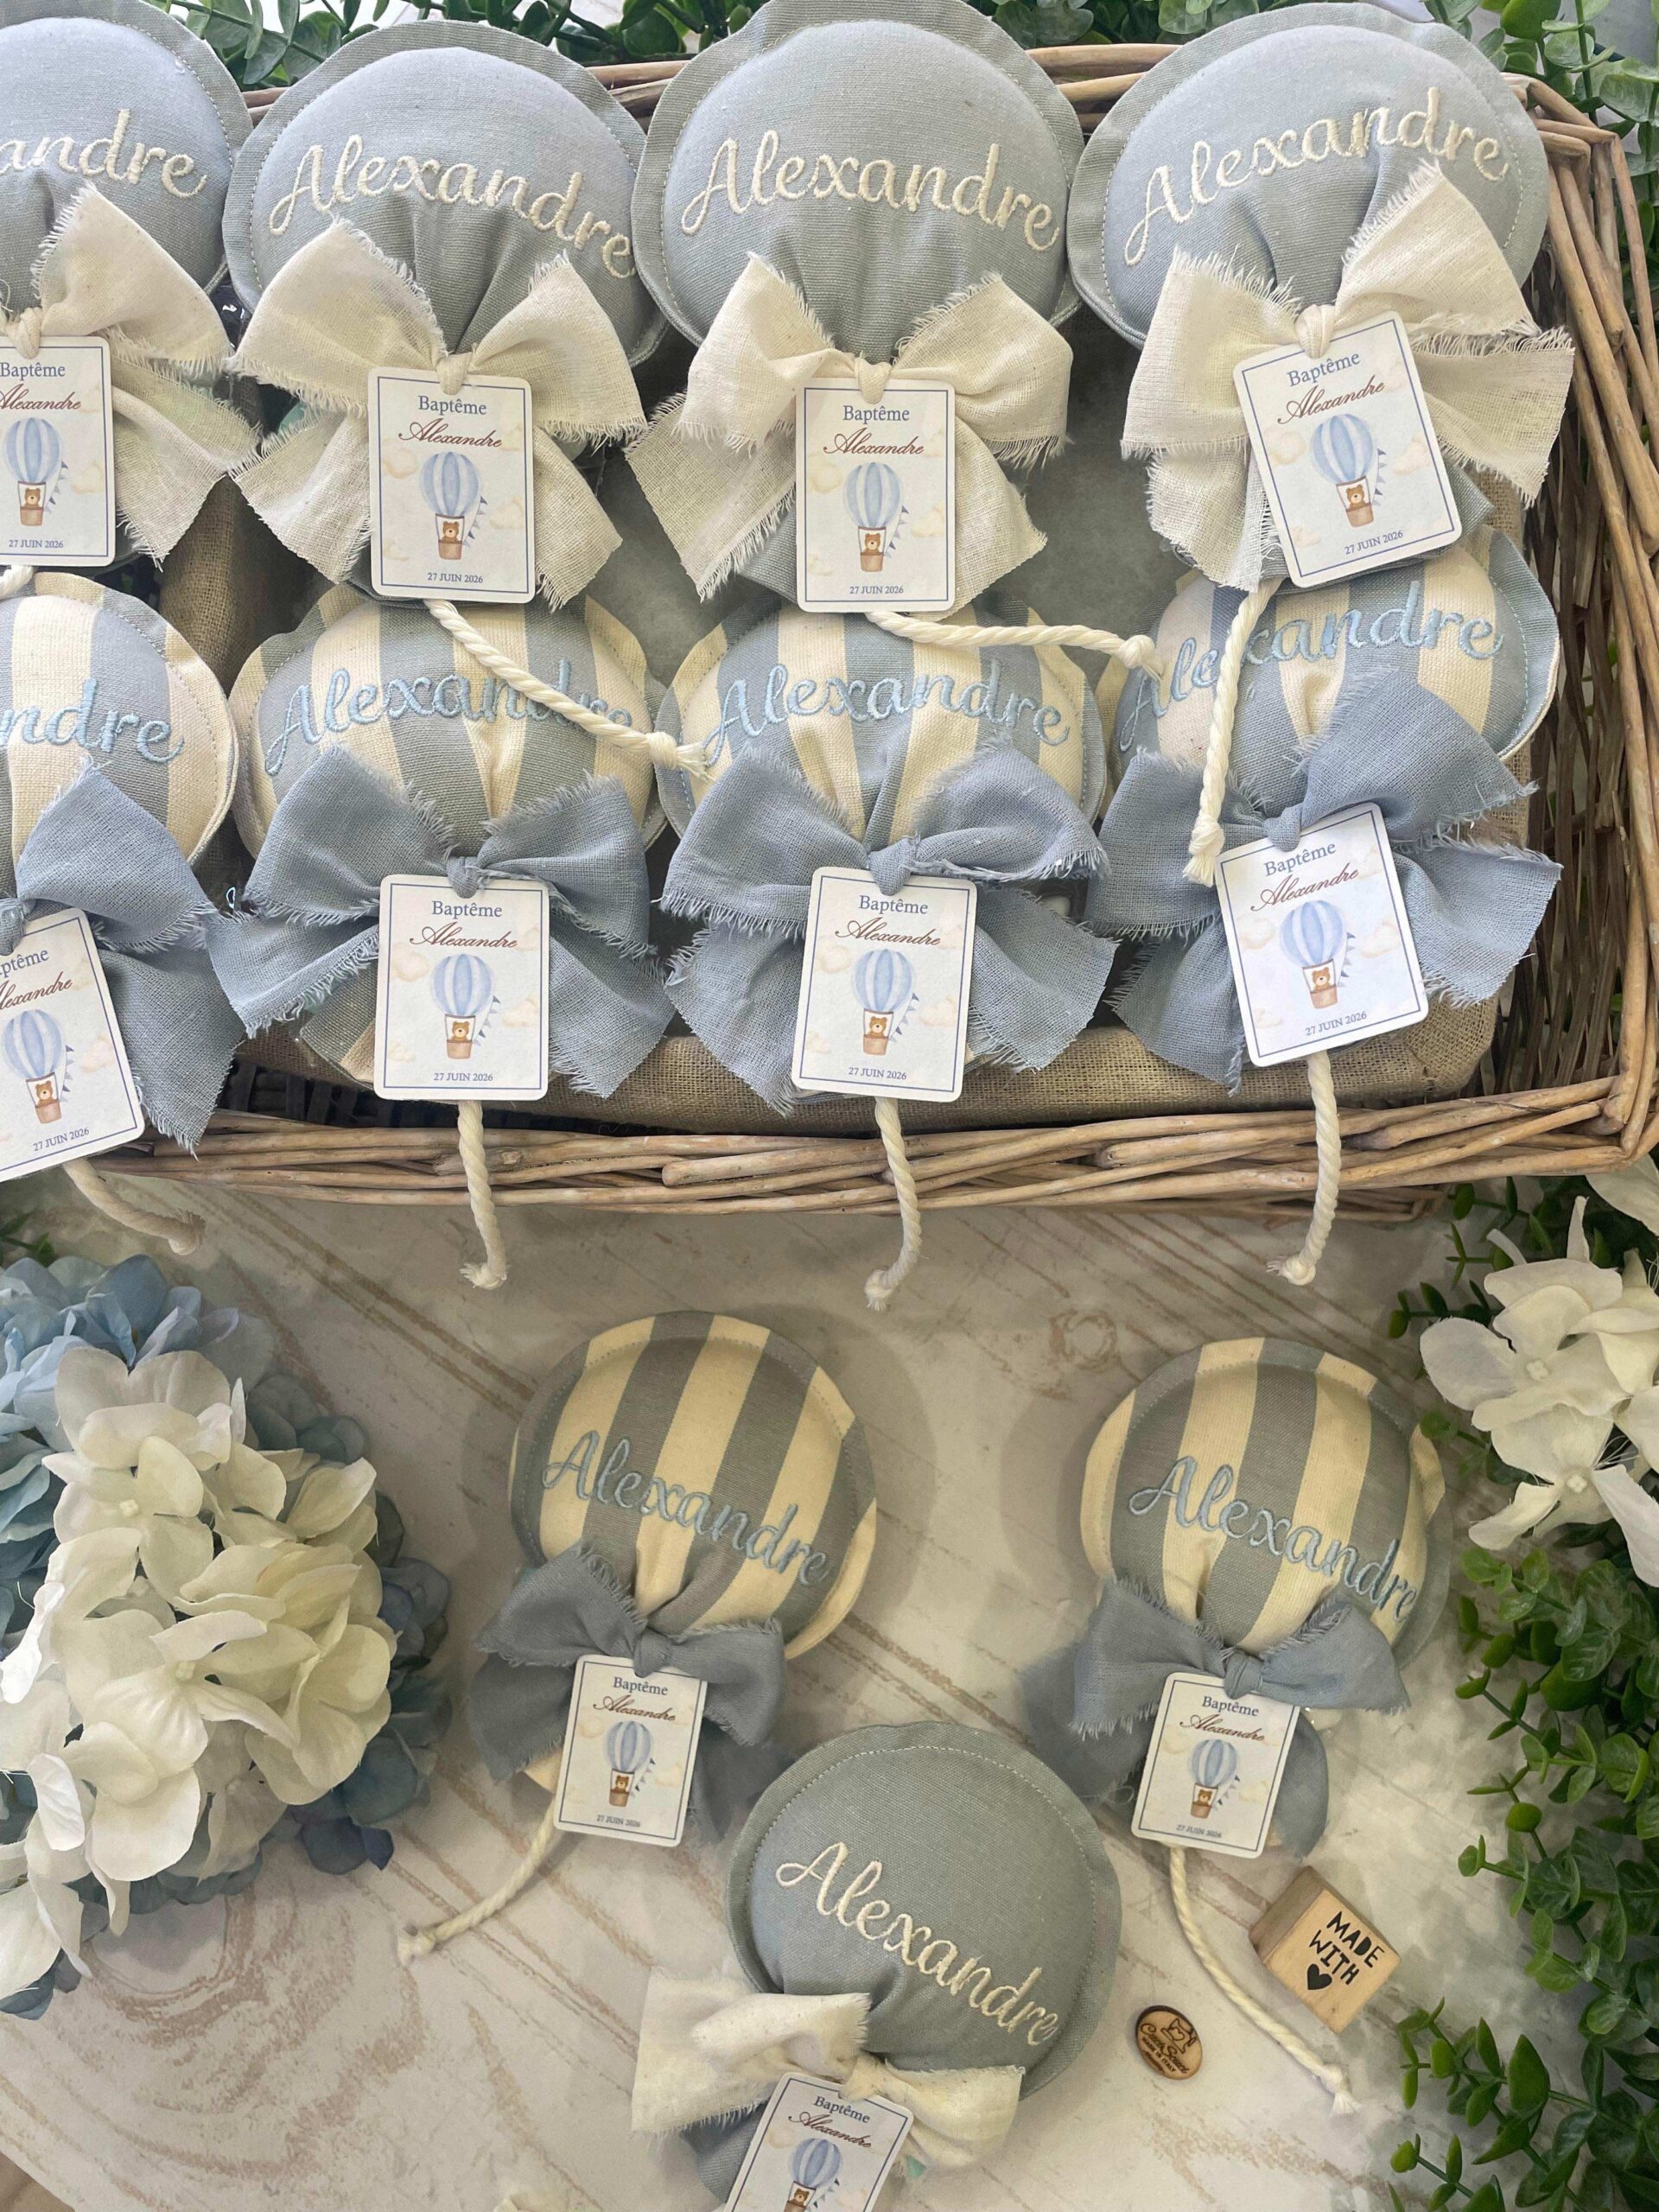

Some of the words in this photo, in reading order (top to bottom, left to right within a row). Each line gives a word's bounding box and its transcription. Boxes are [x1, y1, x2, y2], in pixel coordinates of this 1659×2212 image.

[1124, 86, 1510, 266] Alexandre
[682, 130, 1060, 251] Alexandre
[269, 134, 637, 278] Alexandre
[0, 362, 66, 381] Baptême
[1287, 353, 1361, 387] Baptême
[418, 395, 486, 416] Baptême
[1277, 375, 1385, 424] Alexandre
[843, 405, 909, 424] Baptême
[398, 418, 502, 448] Alexandre
[823, 428, 924, 454] Alexandre
[45, 540, 63, 549] 2026
[1344, 544, 1355, 555] 27
[1356, 537, 1381, 551] JUIN
[1382, 530, 1403, 543] 2026
[428, 572, 438, 581] 27
[439, 573, 461, 582] JUIN
[464, 575, 483, 583] 2026
[885, 586, 904, 594] 2026
[703, 658, 1071, 767] Alexandre
[1264, 842, 1337, 877] Baptême
[1250, 862, 1359, 912] Alexandre
[431, 900, 502, 919] Baptême
[858, 894, 928, 915] Baptême
[409, 921, 518, 948] Alexandre
[835, 916, 941, 946] Alexandre
[0, 950, 49, 978] ptême
[1305, 1026, 1317, 1036] 27
[1318, 1018, 1344, 1033] JUIN
[1344, 1011, 1367, 1026] 2026
[446, 1072, 471, 1081] JUIN
[473, 1073, 493, 1082] 2026
[849, 1066, 860, 1076] 27
[860, 1067, 885, 1078] JUIN
[887, 1070, 906, 1080] 2026
[33, 1141, 44, 1152] 27
[44, 1135, 68, 1149] JUIN
[69, 1128, 90, 1141] 2026
[542, 1430, 830, 1586] Alexandre
[1128, 1455, 1418, 1624] Alexandre
[613, 1676, 669, 1695] Baptême
[593, 1694, 676, 1721] Alexandre
[1202, 1695, 1259, 1717] Baptême
[1179, 1713, 1266, 1741] Alexandre
[776, 1841, 1059, 2046] Alexandre
[1326, 1910, 1385, 1968] MADE
[1309, 1929, 1360, 1985] WITH
[814, 2095, 871, 2124] Baptême
[788, 2111, 872, 2148] Alexandre
